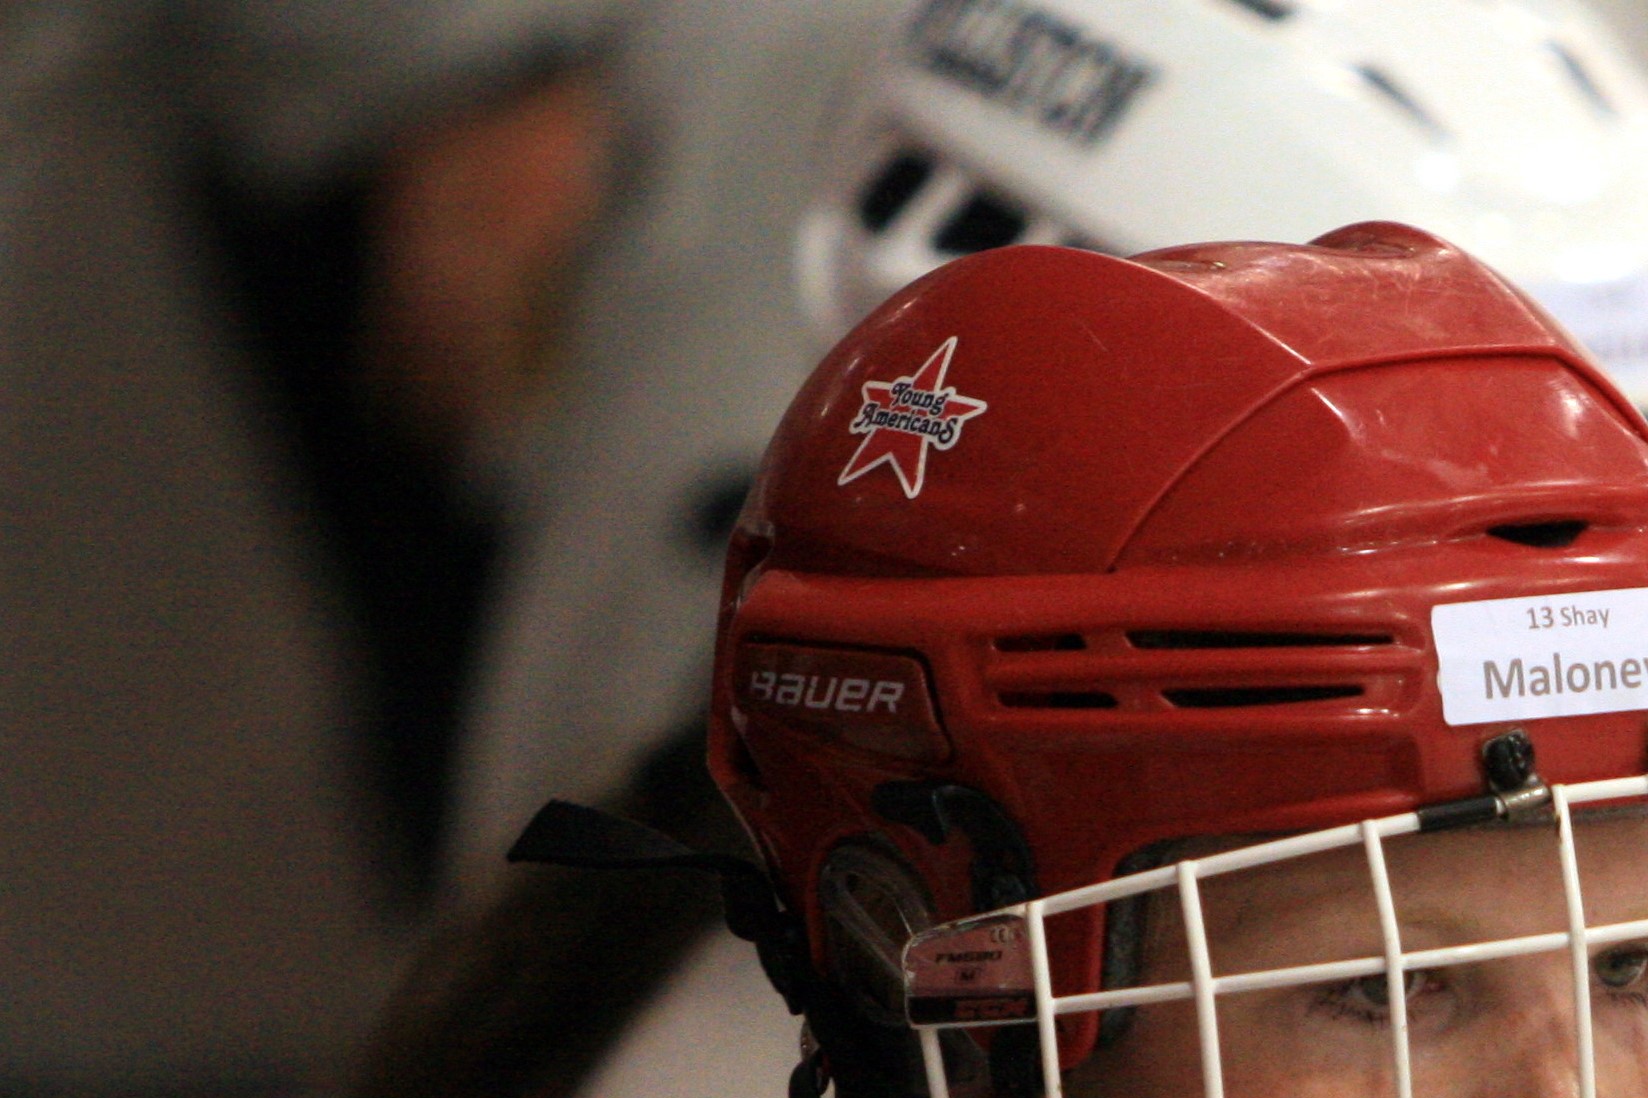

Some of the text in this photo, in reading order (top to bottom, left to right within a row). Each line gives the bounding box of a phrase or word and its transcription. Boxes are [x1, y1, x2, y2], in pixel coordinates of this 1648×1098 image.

[891, 382, 950, 416] Young
[1527, 604, 1611, 630] 13 Shay
